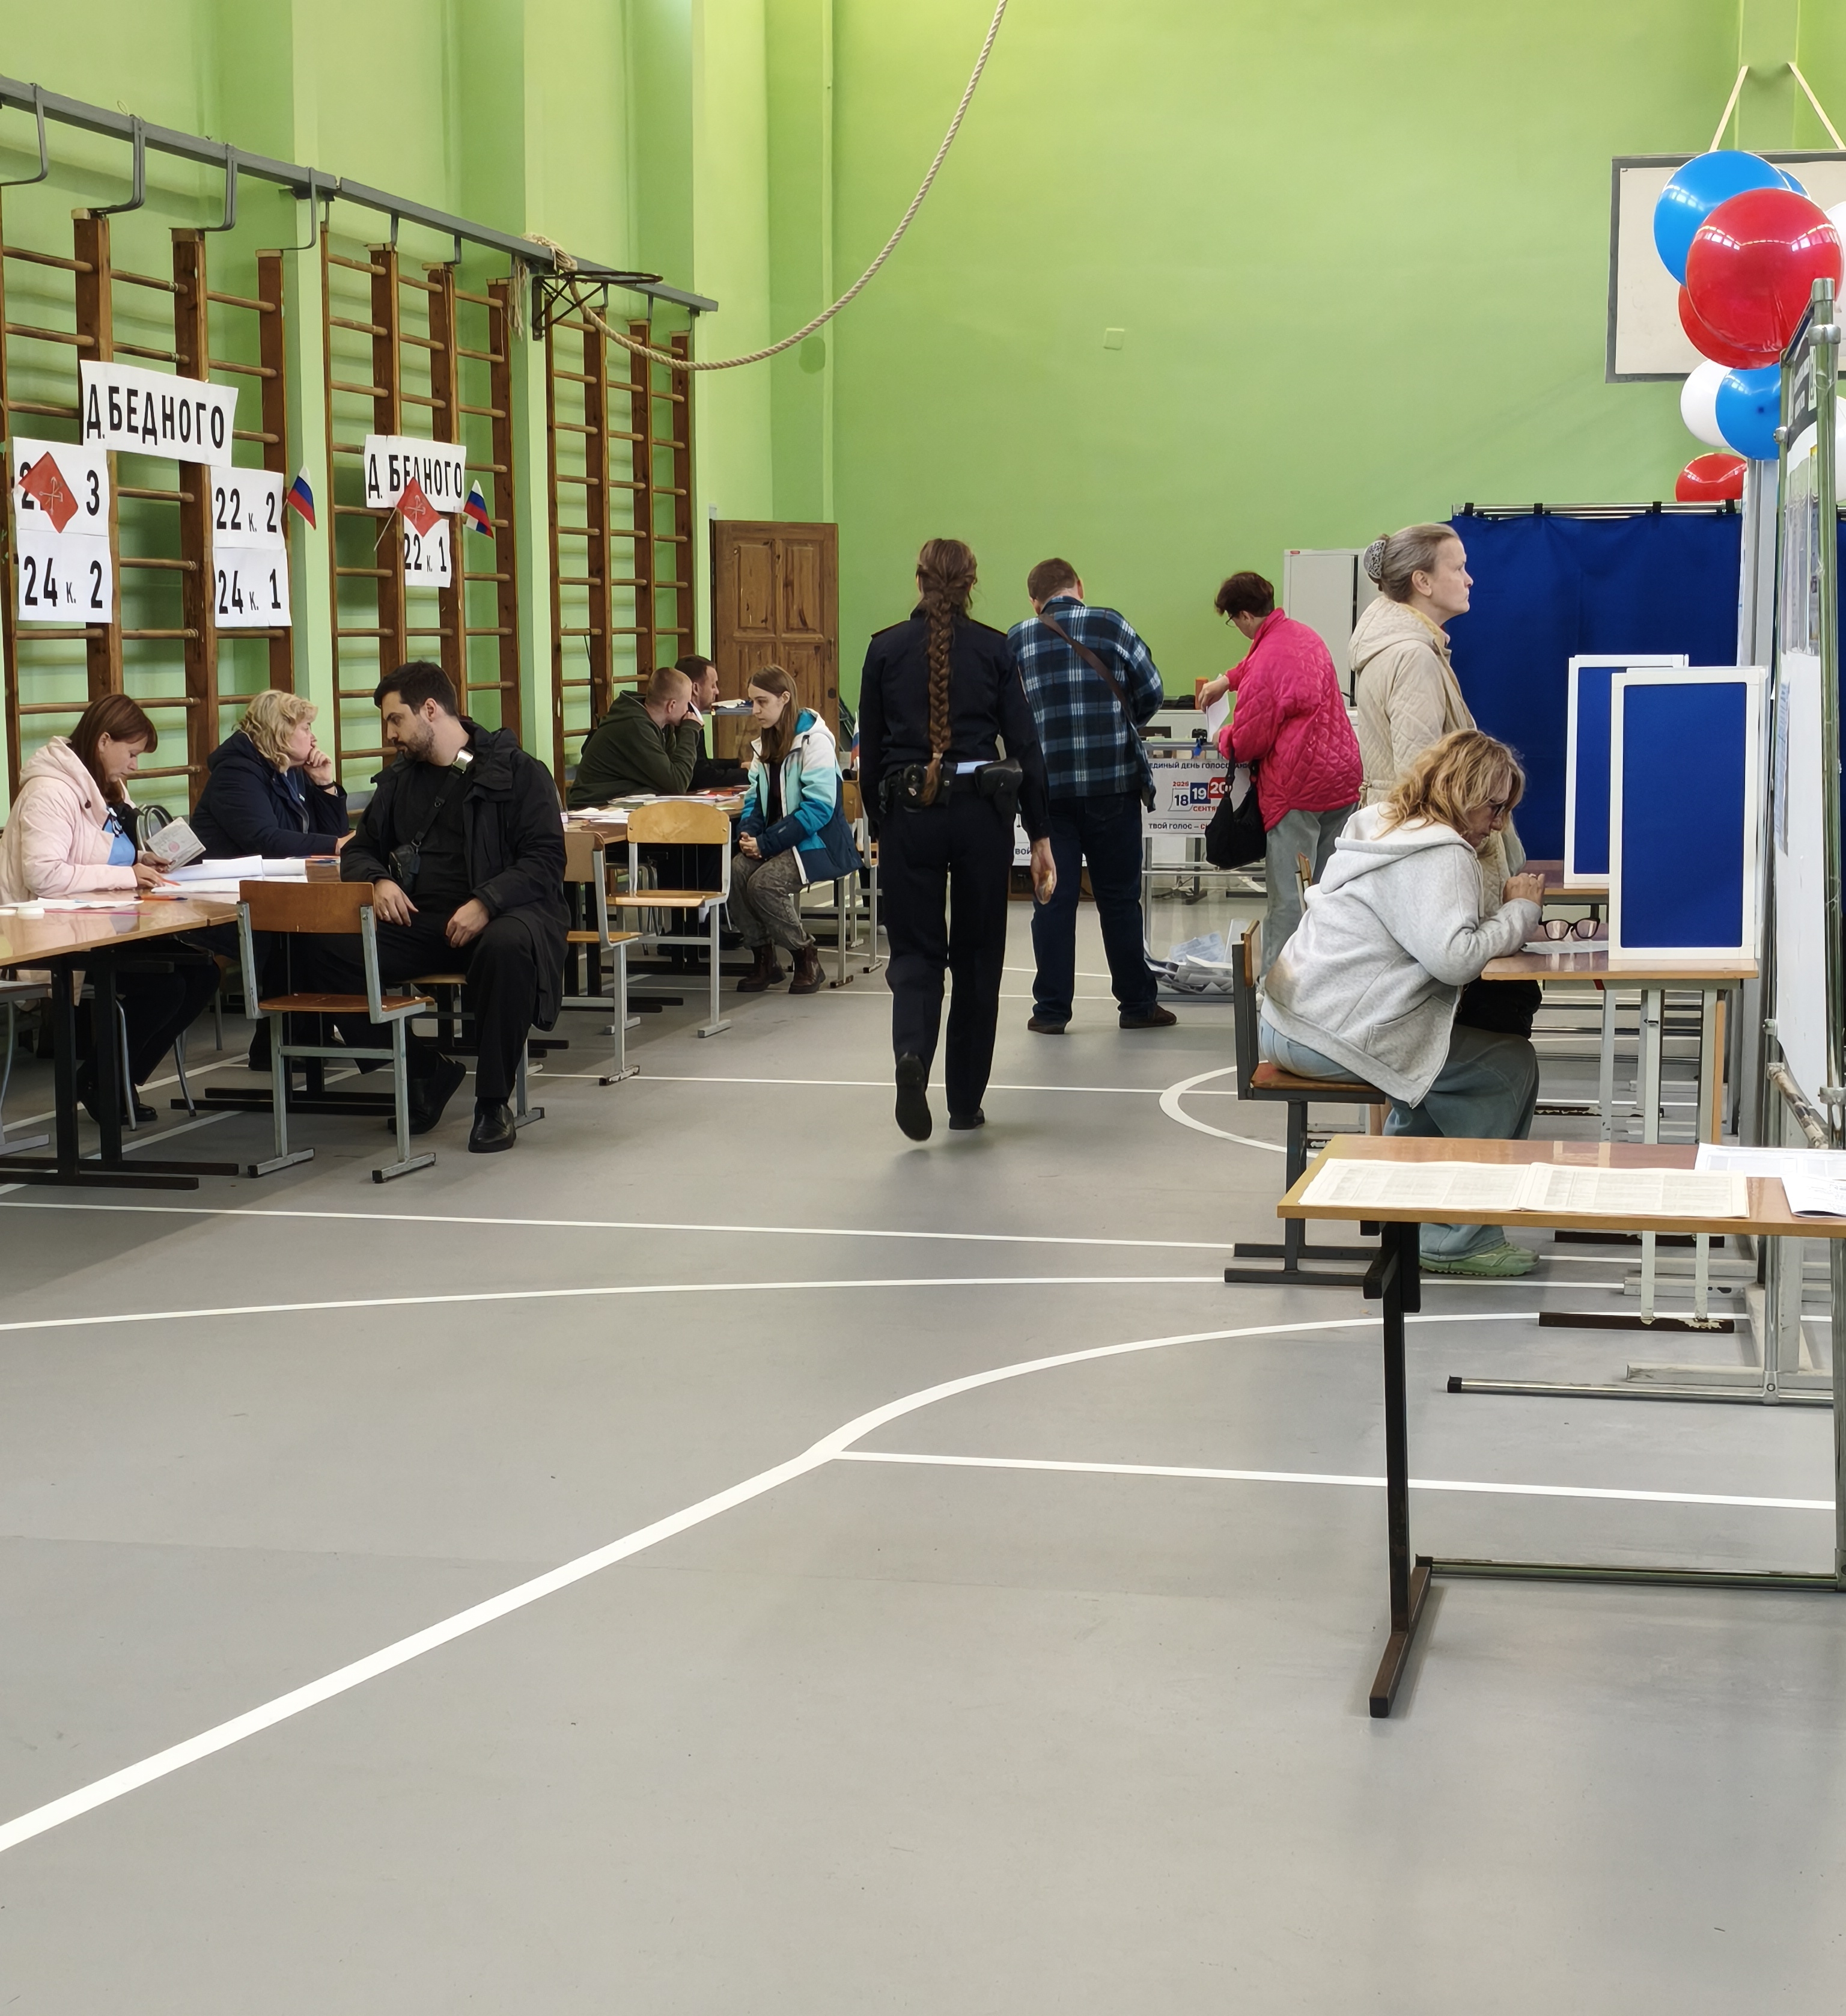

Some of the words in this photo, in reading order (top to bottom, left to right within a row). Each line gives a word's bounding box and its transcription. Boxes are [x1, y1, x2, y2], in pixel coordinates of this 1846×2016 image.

[19, 462, 43, 512] 2
[86, 469, 100, 516] 3
[368, 454, 382, 499] Д.
[215, 487, 242, 530] 22
[266, 492, 277, 533] 2
[403, 533, 422, 570] 22
[439, 536, 447, 572] 1
[24, 555, 58, 607] 24
[90, 560, 103, 609] 2
[218, 569, 243, 614] 24
[269, 569, 281, 609] 1
[1174, 795, 1189, 806] 18
[1192, 787, 1207, 800] 19
